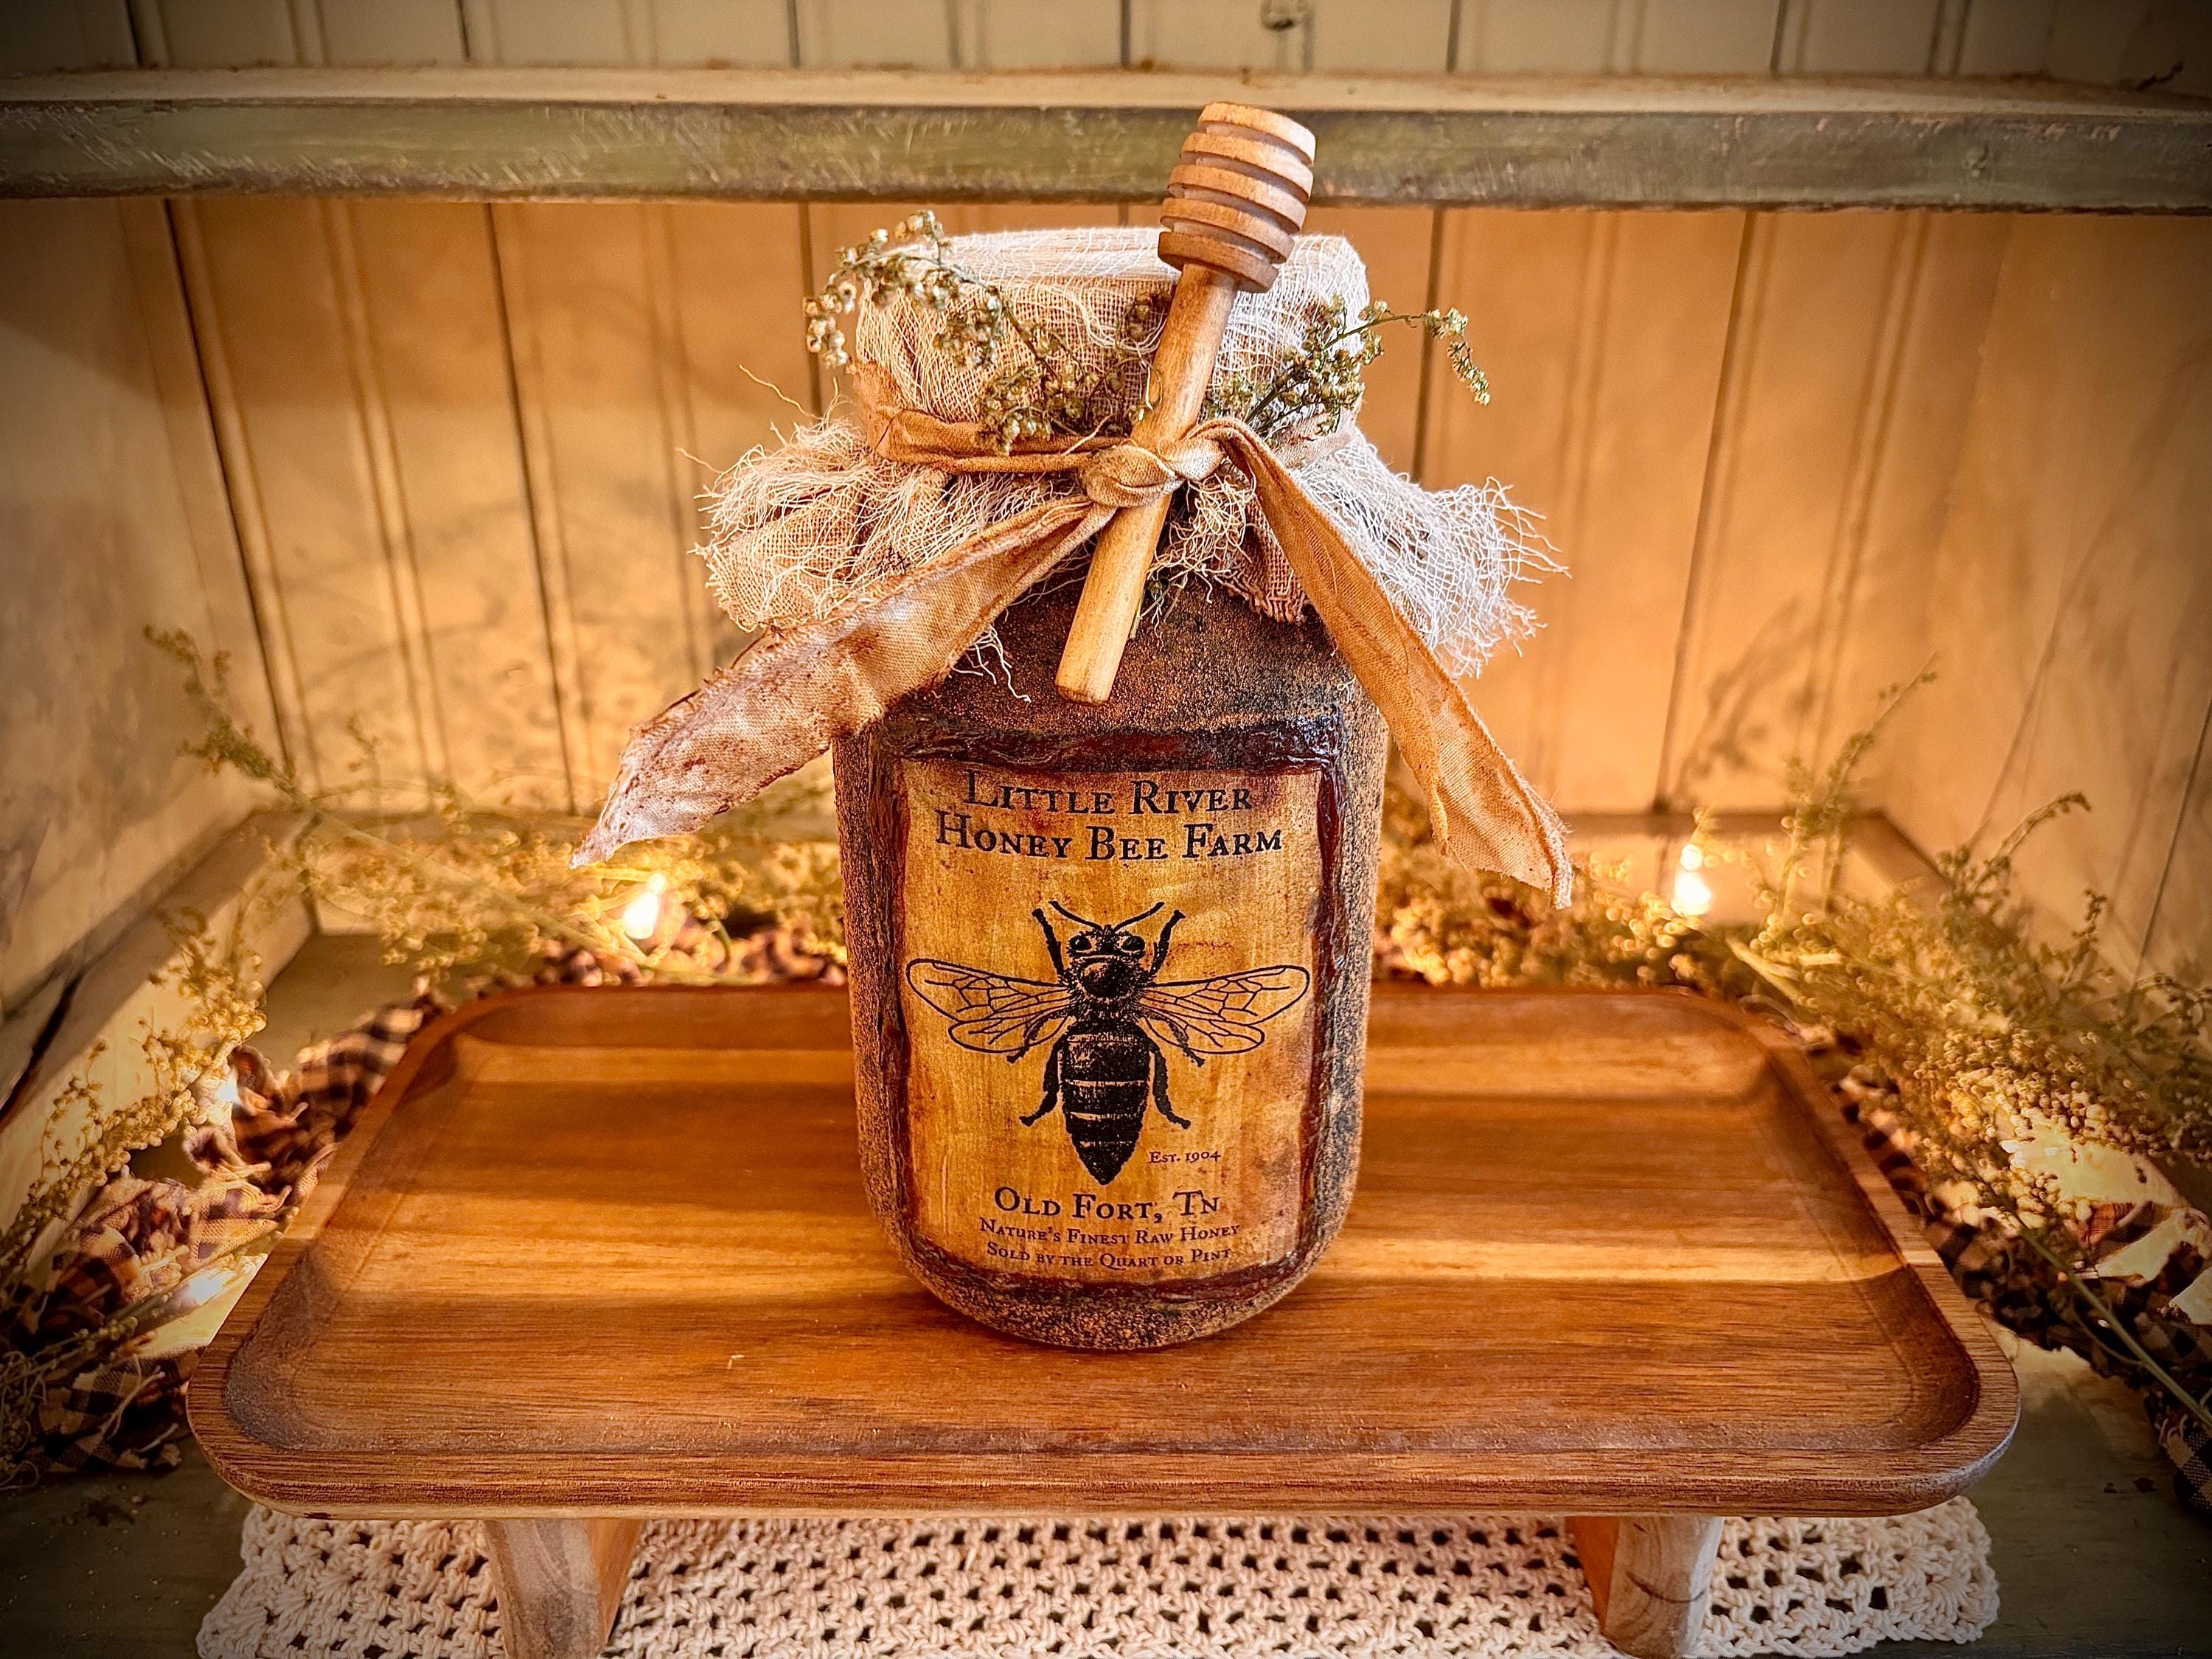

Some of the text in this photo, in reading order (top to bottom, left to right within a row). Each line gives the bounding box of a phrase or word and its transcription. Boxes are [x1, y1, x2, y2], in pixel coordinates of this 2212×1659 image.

[963, 769, 1252, 815] LITTLE RIVER
[935, 810, 1281, 860] HONEY BEE FARM
[1149, 1150, 1221, 1164] EST. 1904
[995, 1186, 1220, 1224] OLD FORT, TN
[979, 1217, 1240, 1245] NATURE'S FINEST RAW HONEY
[987, 1242, 1030, 1261] SOLD
[1036, 1253, 1054, 1265] BY
[1059, 1256, 1094, 1267] THE
[1099, 1253, 1158, 1271] QUART
[1191, 1248, 1231, 1263] PINT
